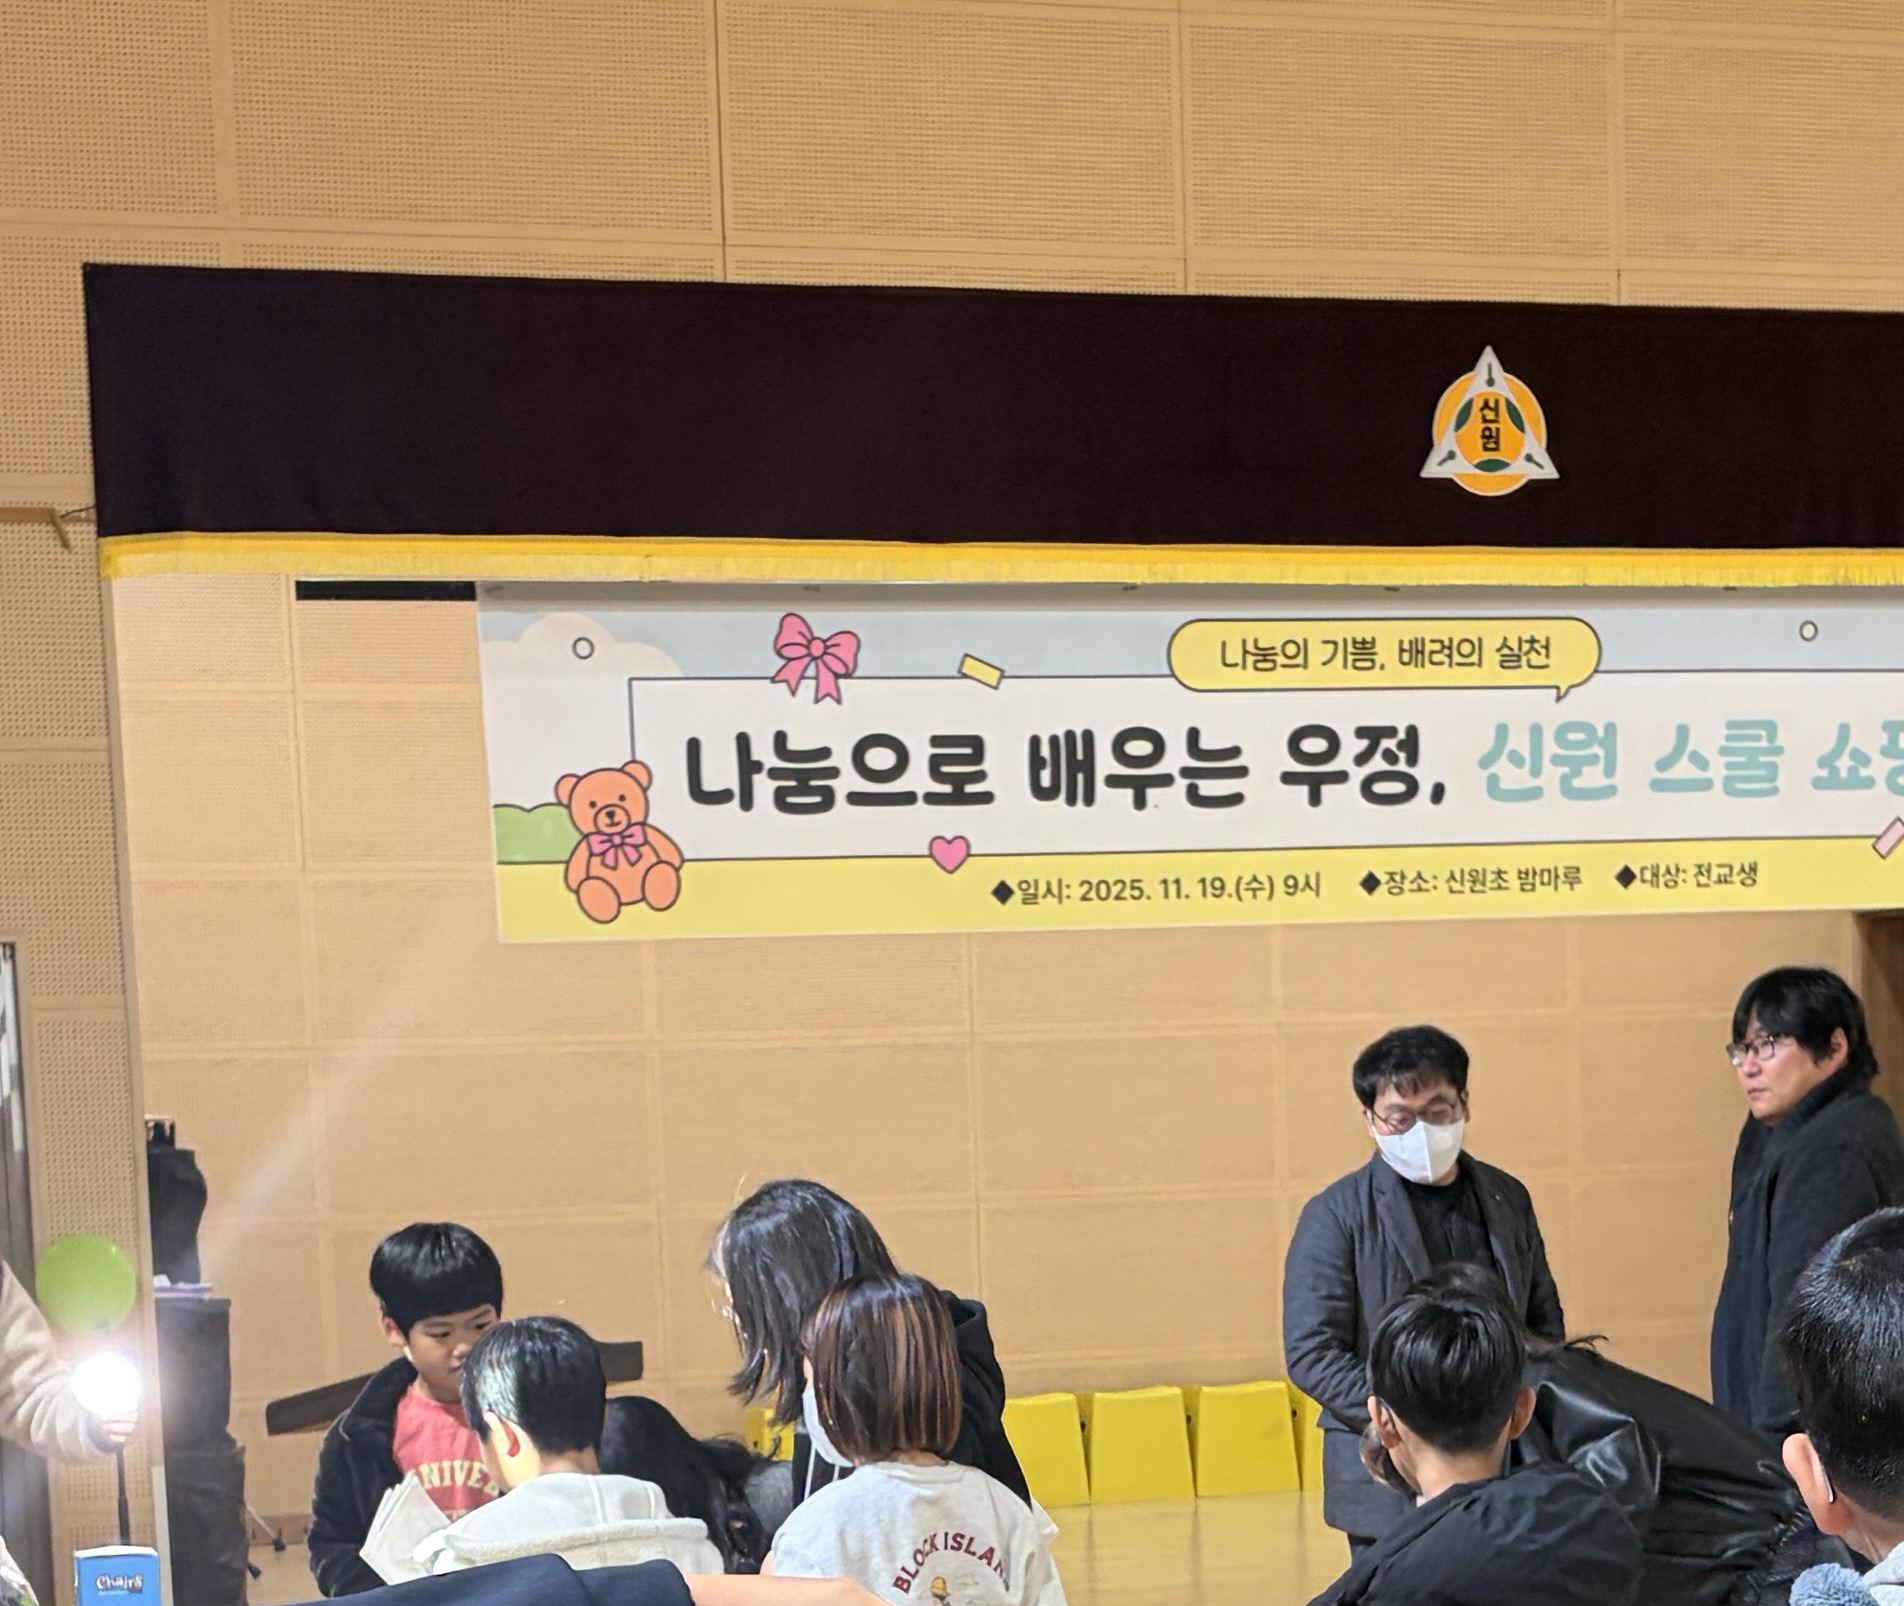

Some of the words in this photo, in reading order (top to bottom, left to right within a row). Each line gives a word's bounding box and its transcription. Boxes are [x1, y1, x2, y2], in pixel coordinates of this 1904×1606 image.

[1478, 397, 1501, 452] 신원
[1220, 637, 1309, 672] 나눔의
[1320, 637, 1386, 672] 기쁨,
[1397, 635, 1484, 670] 배려의
[1494, 635, 1552, 670] 실천
[685, 728, 997, 816] 나눔으로
[1027, 723, 1252, 812] 배우는
[1278, 722, 1447, 809] 우정,
[1477, 720, 1620, 803] 신원
[1648, 719, 1786, 799] 스쿨
[1078, 877, 1152, 902] 2025.
[1158, 876, 1191, 901] 11.
[1196, 873, 1275, 902] 19.(수)
[1282, 871, 1323, 899] 9시
[1443, 867, 1511, 894] 신원초
[1516, 865, 1584, 893] 밤마루
[1693, 860, 1759, 889] 전교생
[892, 1531, 940, 1595] BLOCK
[943, 1531, 1011, 1593] ISLAN
